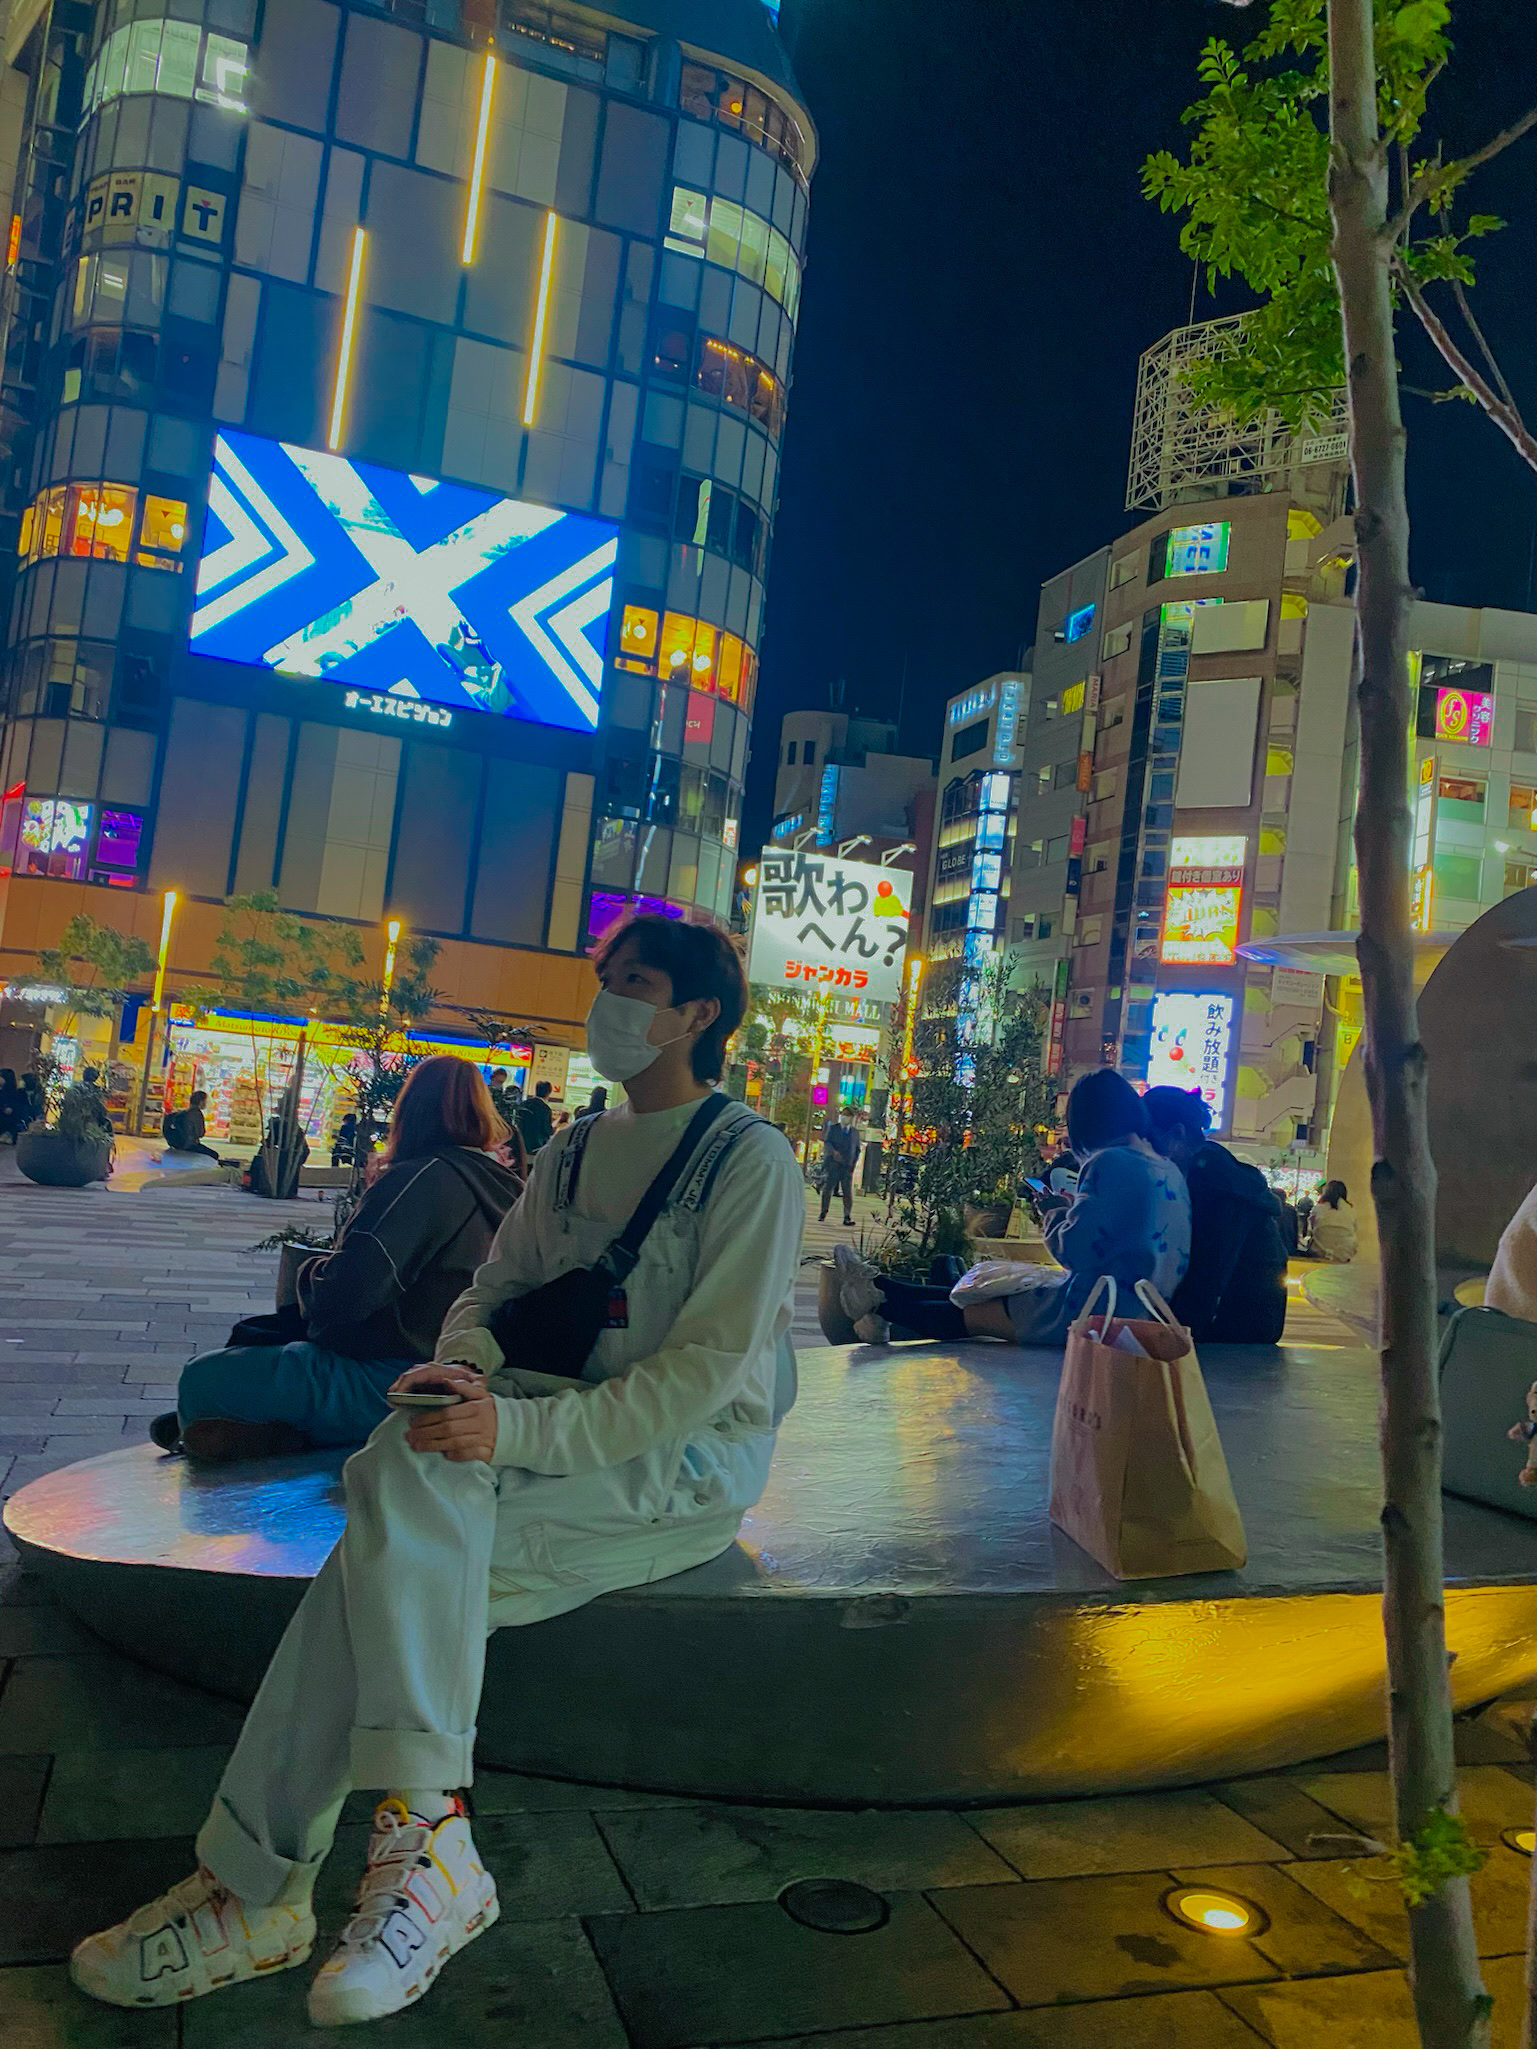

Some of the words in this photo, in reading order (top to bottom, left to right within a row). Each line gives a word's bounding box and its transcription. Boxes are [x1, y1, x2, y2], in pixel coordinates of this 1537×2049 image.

[1090, 679, 1099, 708] MARIA
[1471, 704, 1481, 744] クリニック
[1481, 697, 1491, 723] 美容
[942, 854, 967, 871] GLOBE
[763, 853, 869, 919] 歌わ
[784, 960, 869, 989] ジャンカラ
[1202, 1003, 1225, 1073] 飲み放題
